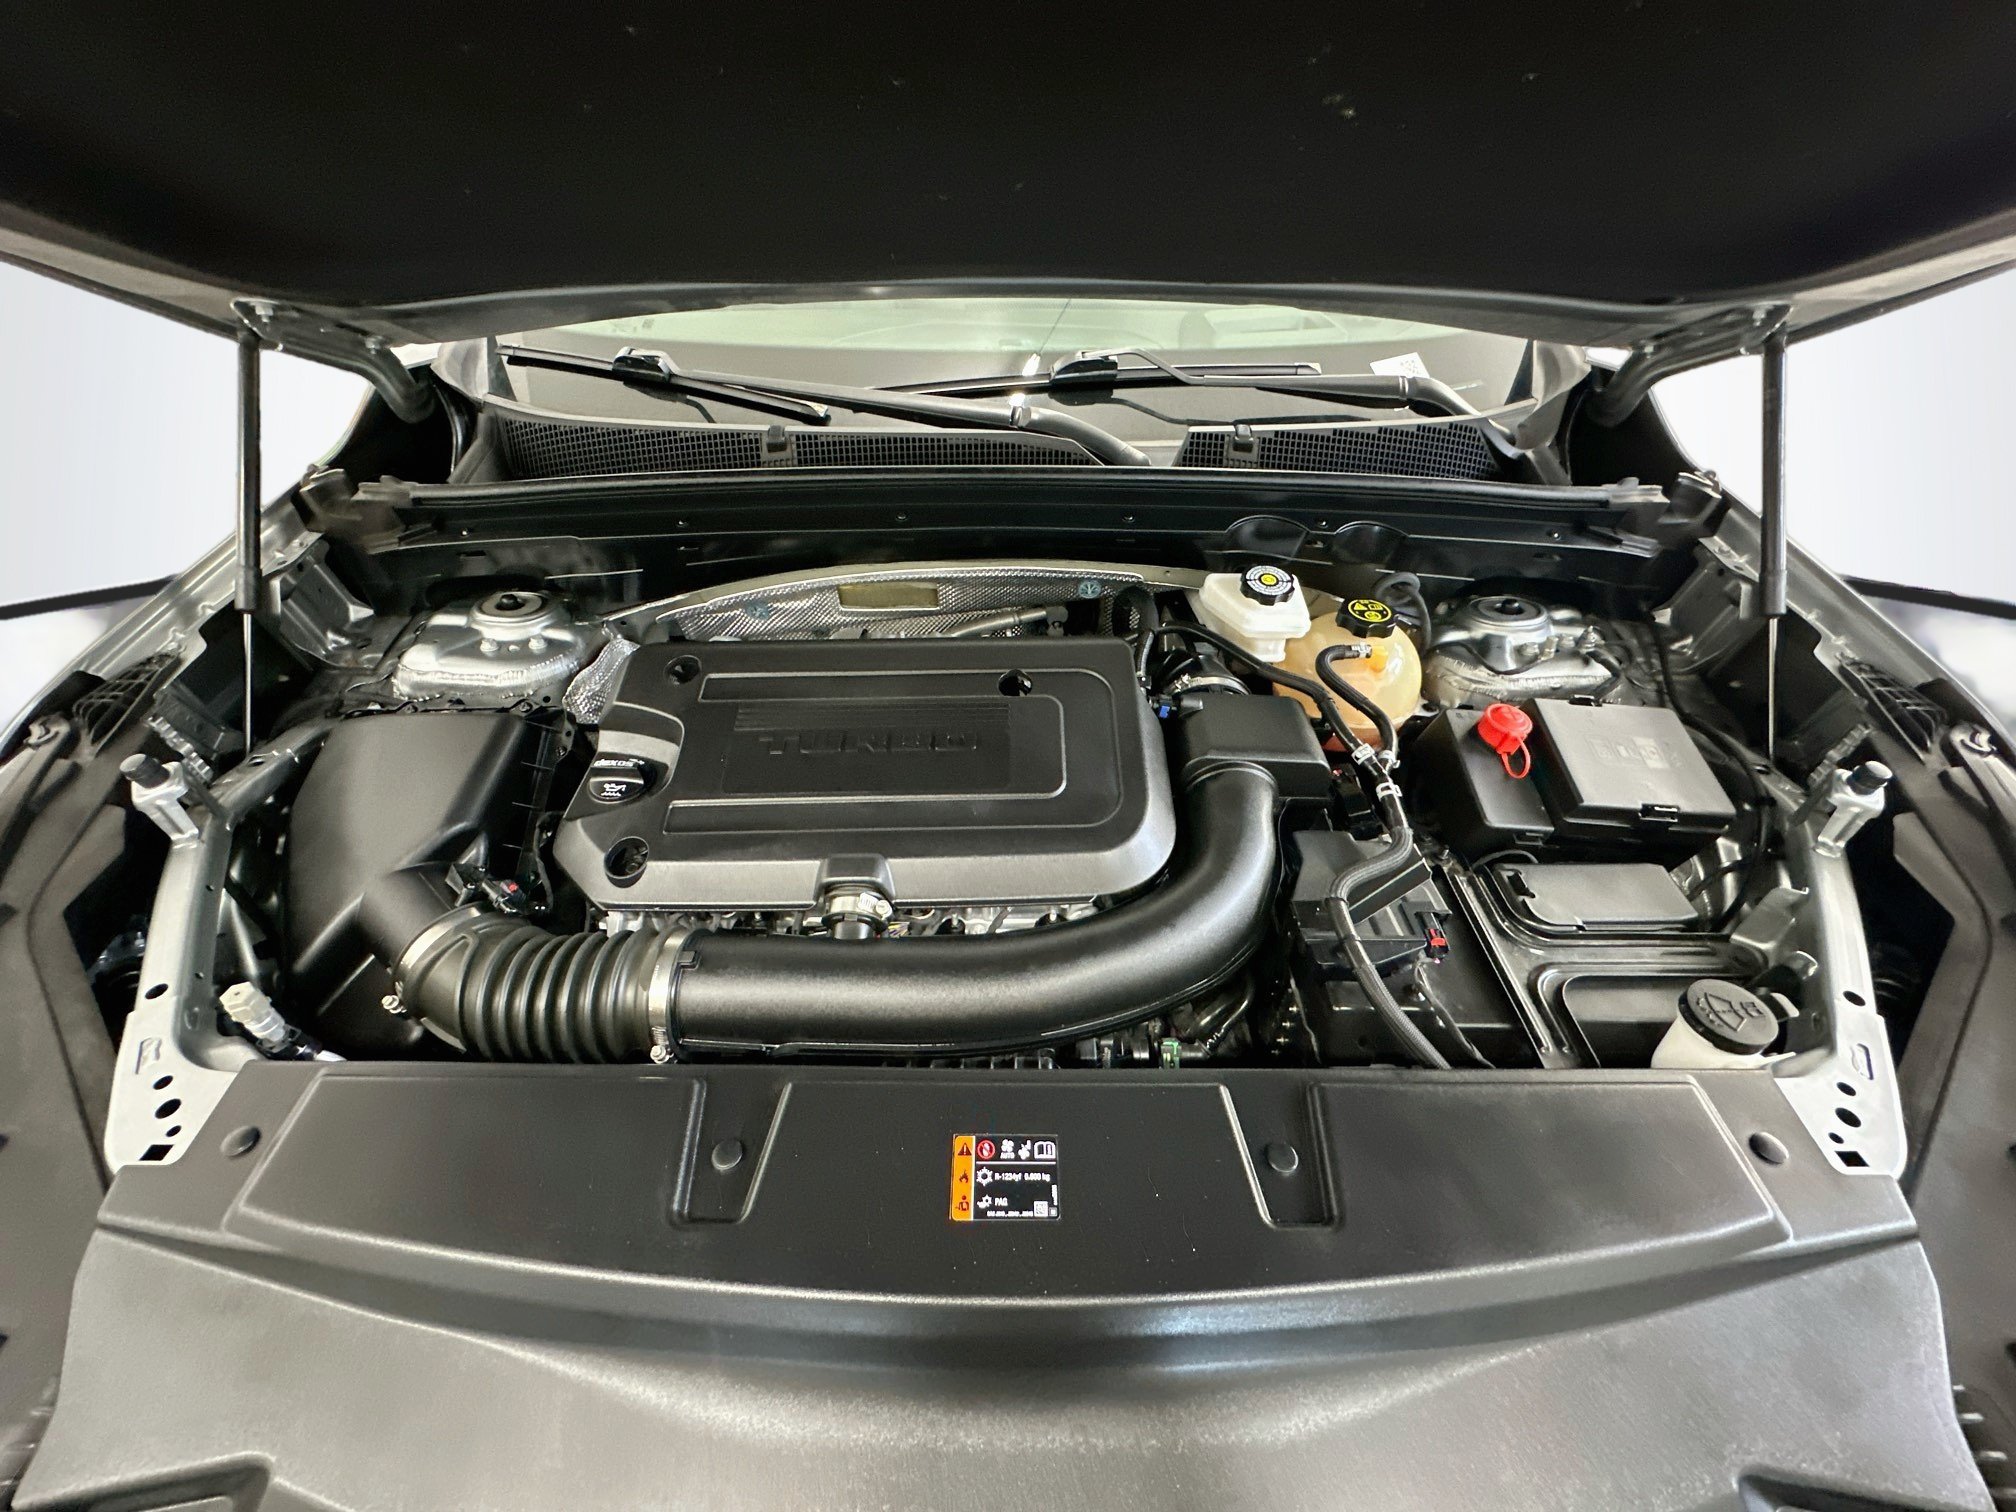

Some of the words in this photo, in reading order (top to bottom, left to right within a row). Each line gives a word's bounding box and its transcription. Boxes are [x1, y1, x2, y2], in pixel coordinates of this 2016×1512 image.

[759, 734, 979, 755] TURBO
[995, 1173, 1021, 1181] R-1234yf
[1042, 1173, 1050, 1182] kg
[995, 1197, 1008, 1206] PAG
